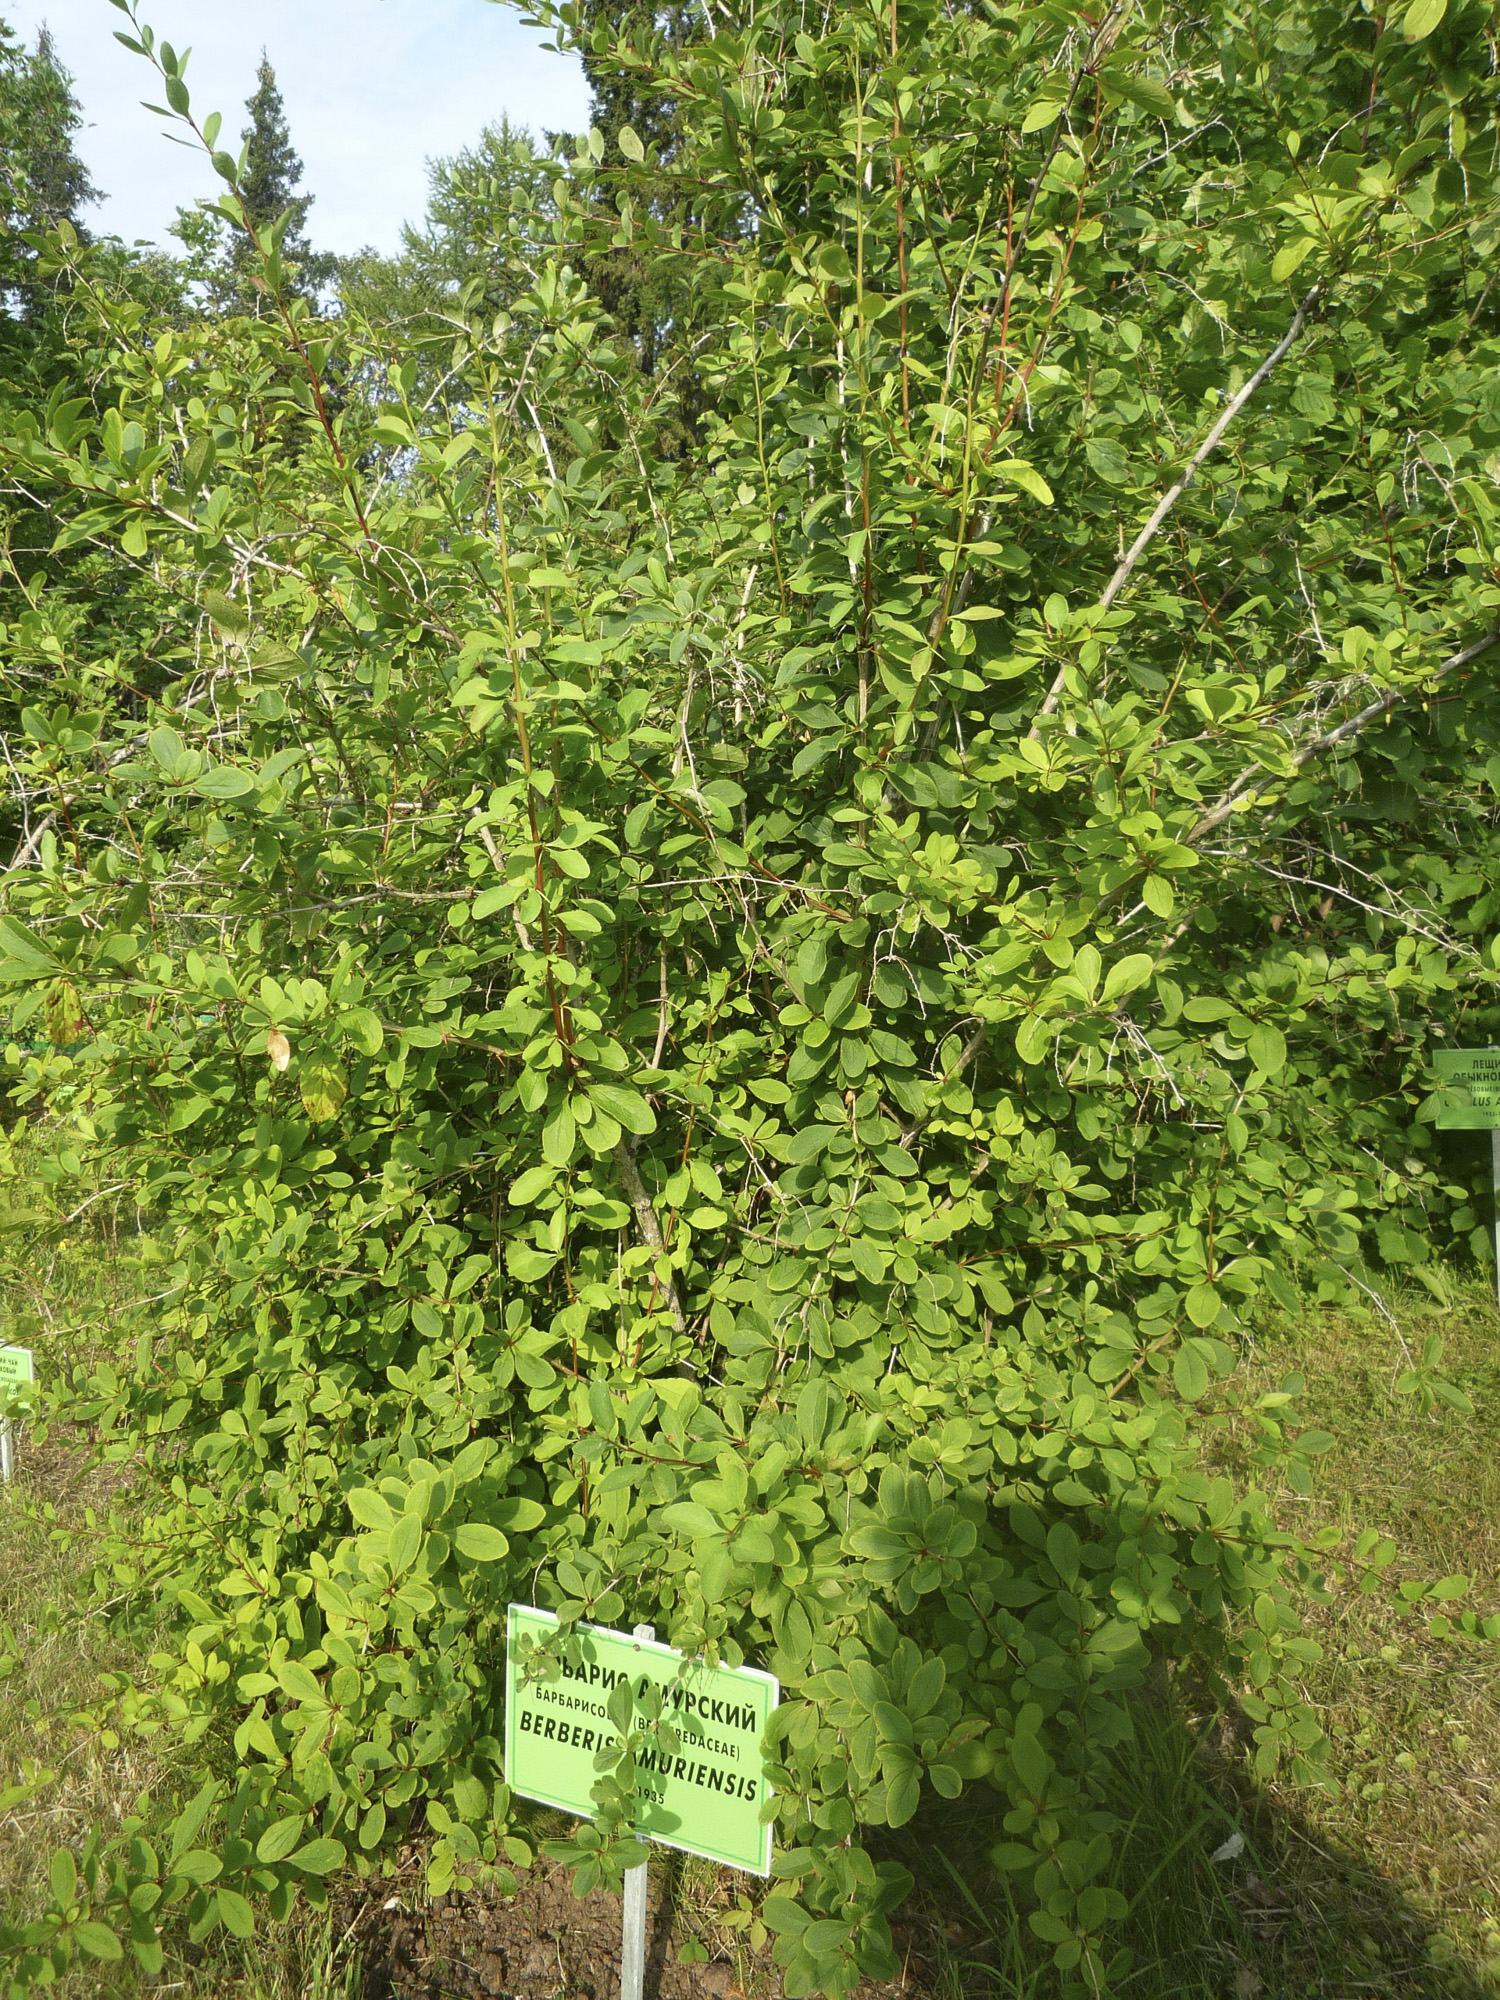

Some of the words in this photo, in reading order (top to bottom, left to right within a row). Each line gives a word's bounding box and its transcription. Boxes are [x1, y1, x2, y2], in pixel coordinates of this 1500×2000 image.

[1453, 1072, 1500, 1082] ОБЫКНО
[519, 1710, 615, 1754] BERBERIS
[637, 1786, 665, 1805] 1935
